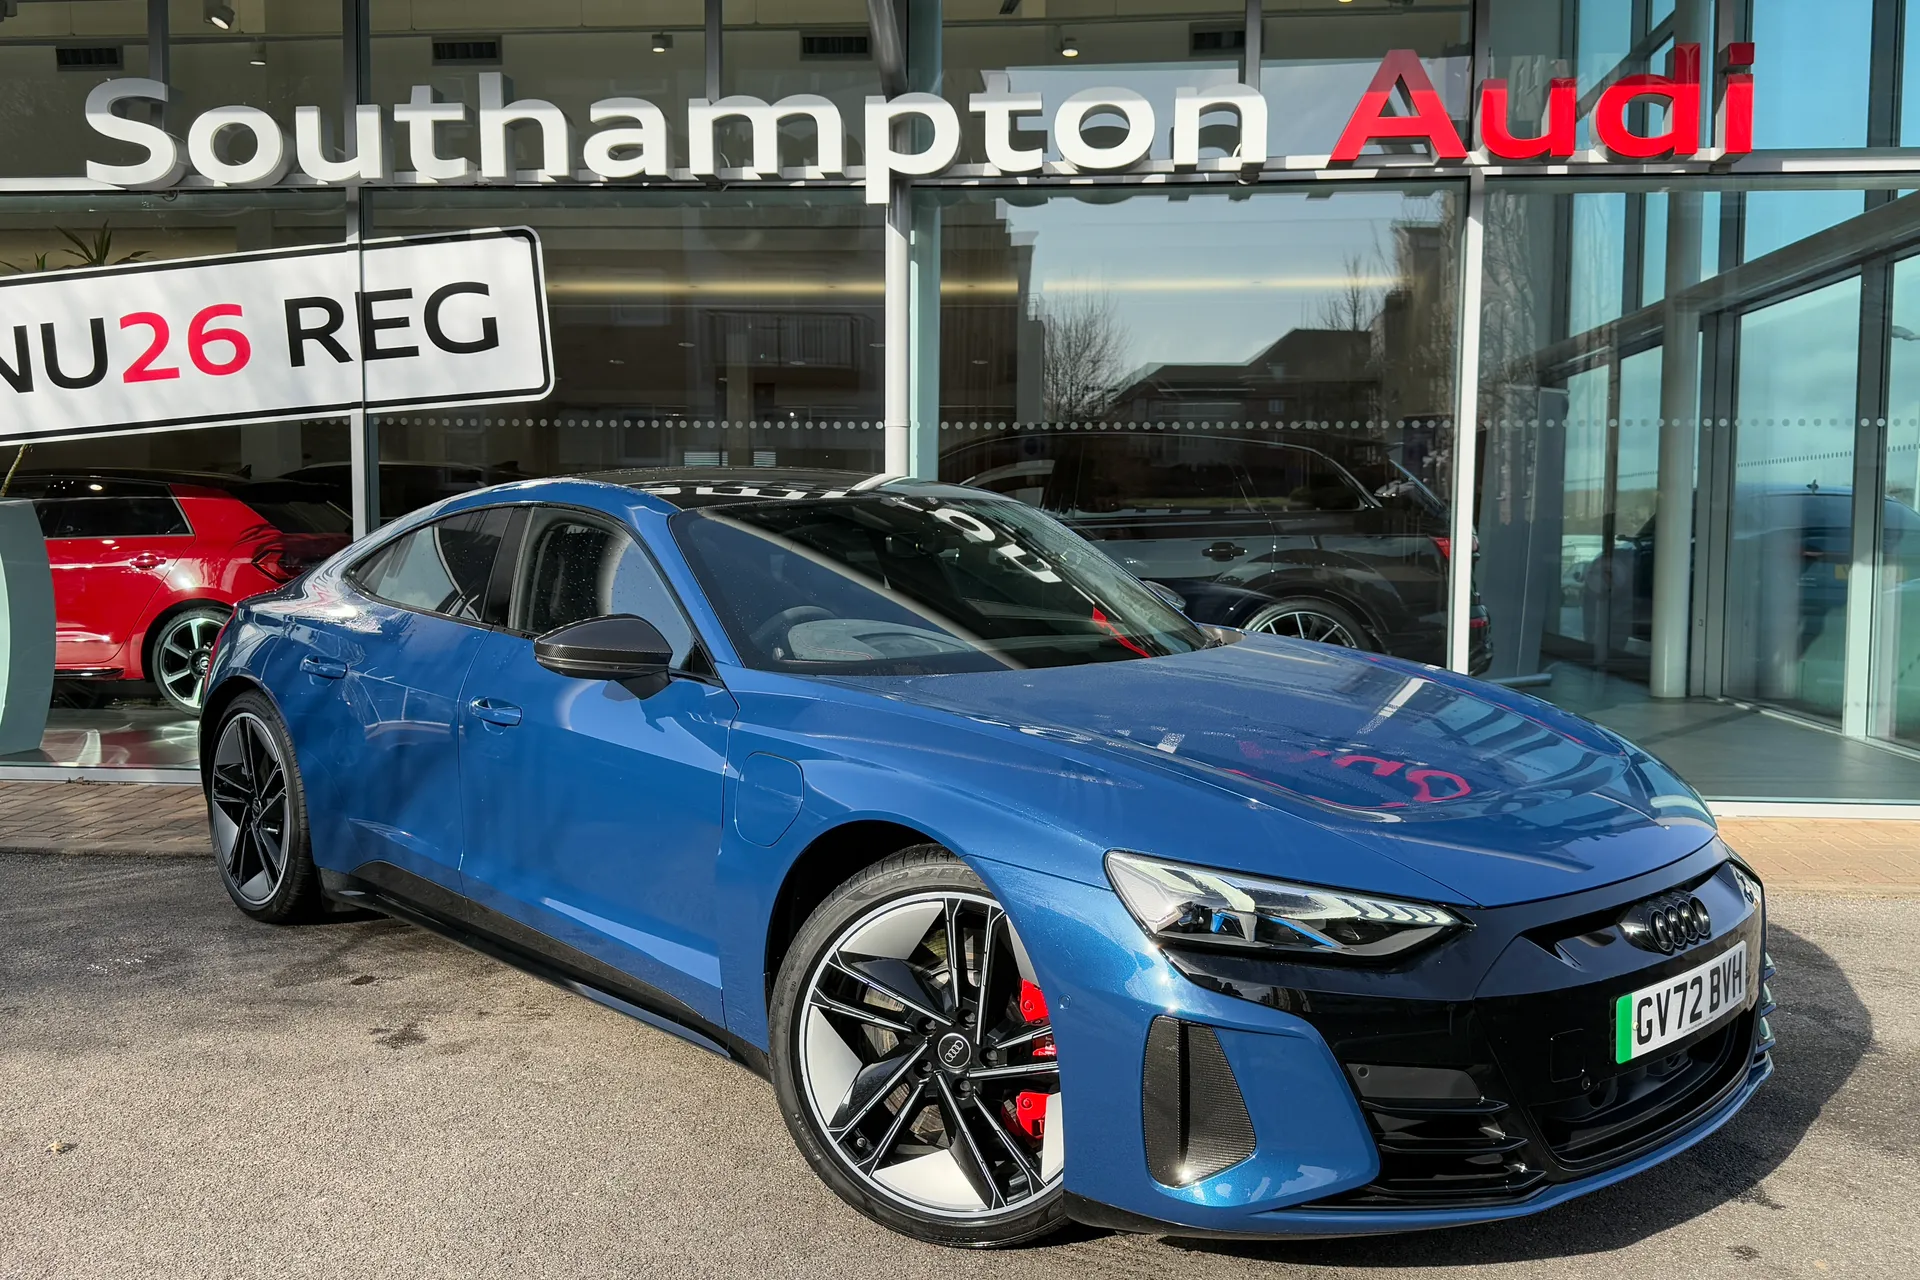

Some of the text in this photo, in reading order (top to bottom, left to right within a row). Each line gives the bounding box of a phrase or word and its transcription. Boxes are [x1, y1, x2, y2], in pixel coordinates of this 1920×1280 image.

[85, 42, 1755, 204] Southampton Audi
[284, 282, 500, 367] REG
[1637, 950, 1743, 1045] GV72 BVH
